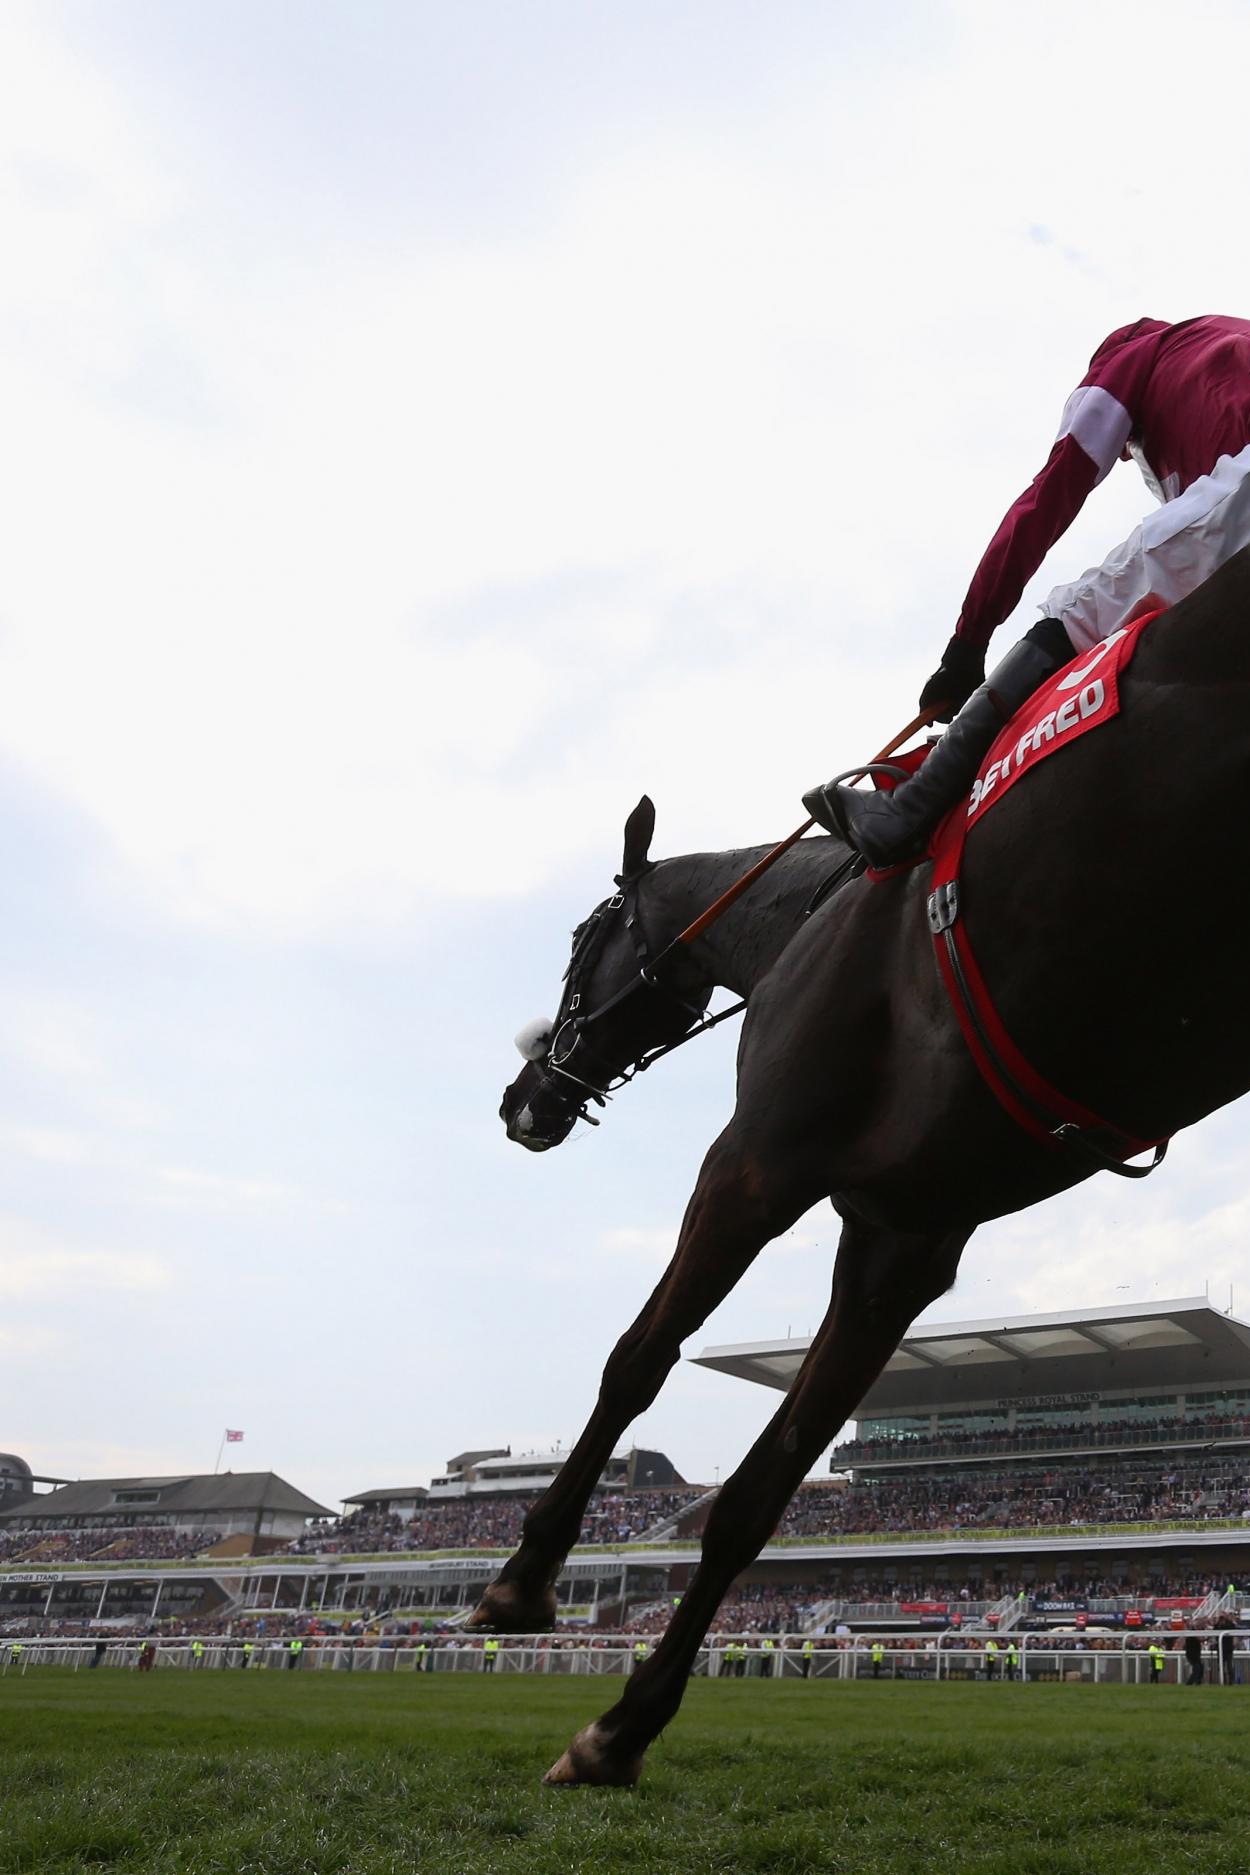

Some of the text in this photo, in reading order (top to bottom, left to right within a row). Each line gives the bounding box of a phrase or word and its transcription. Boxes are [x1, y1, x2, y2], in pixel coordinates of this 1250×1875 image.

[968, 678, 1105, 817] BETFRED
[1070, 1392, 1100, 1403] STAND
[35, 1573, 59, 1581] STAND
